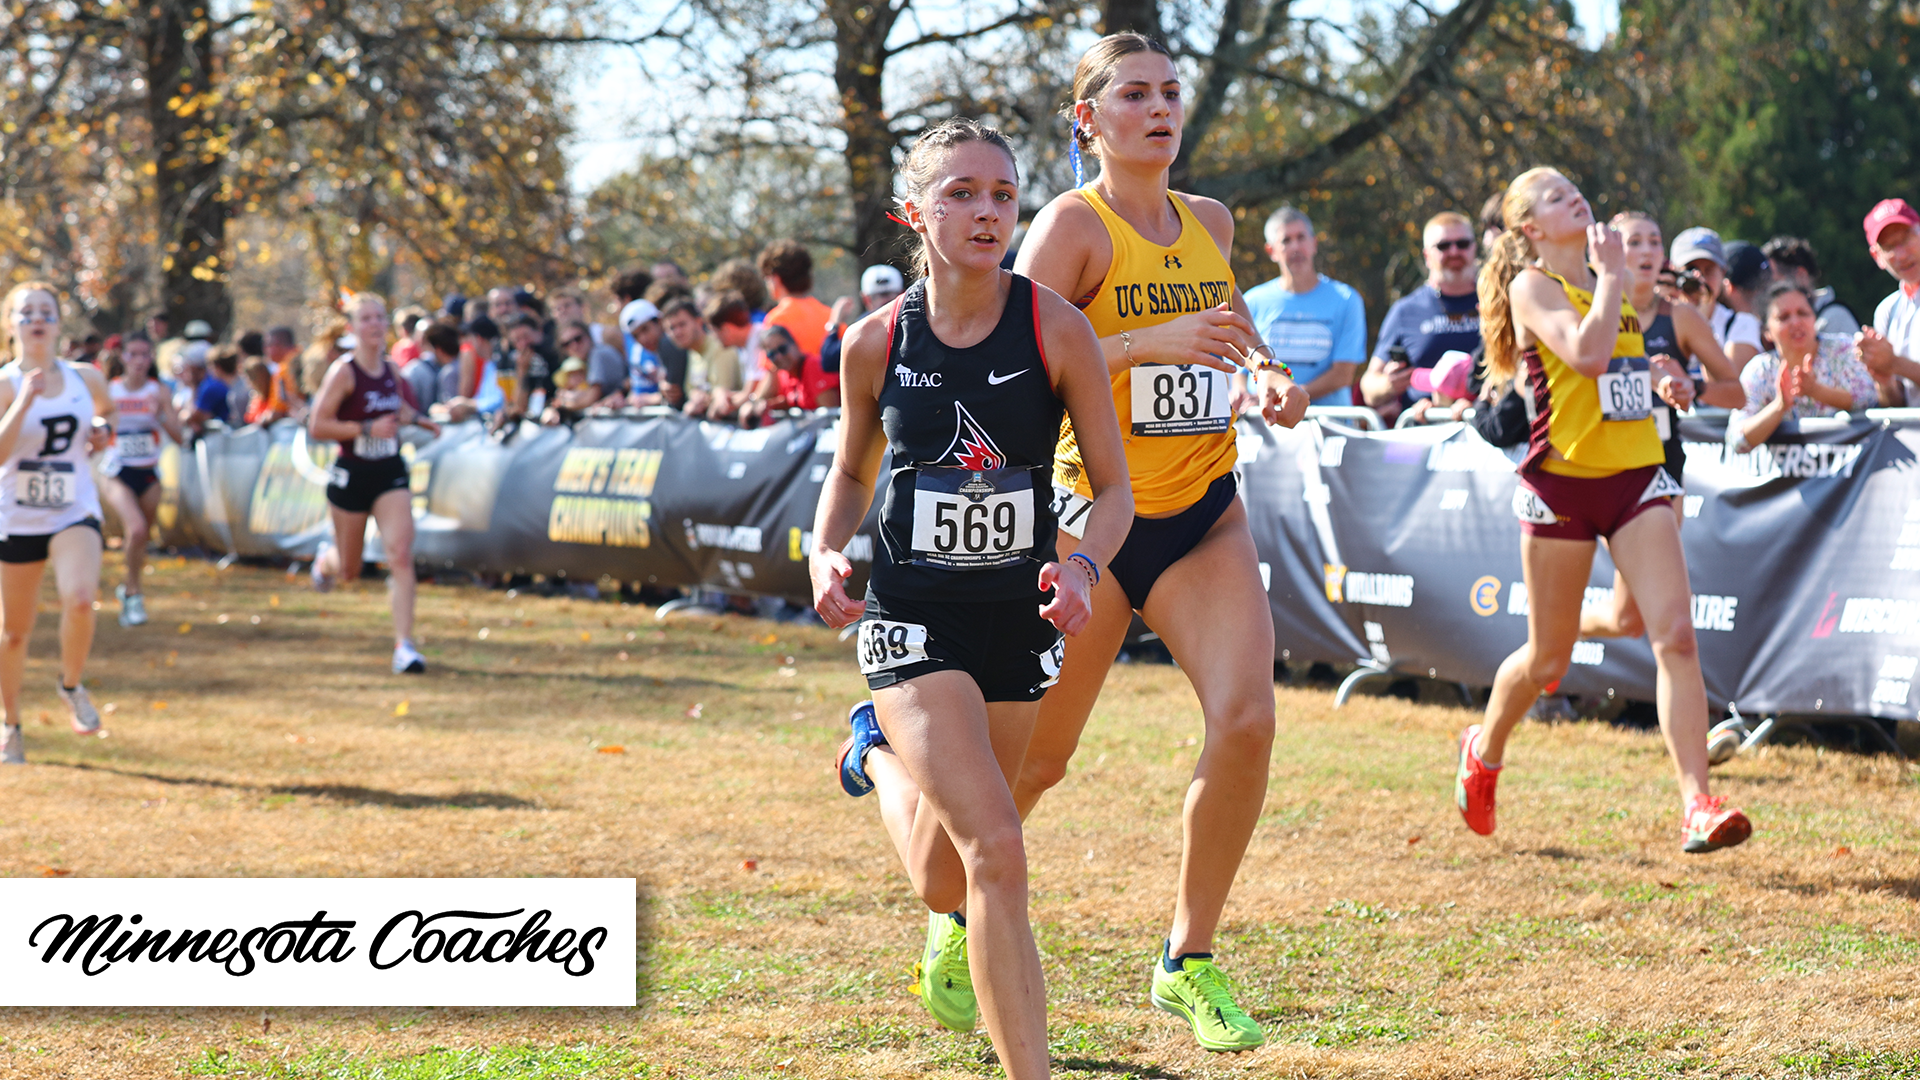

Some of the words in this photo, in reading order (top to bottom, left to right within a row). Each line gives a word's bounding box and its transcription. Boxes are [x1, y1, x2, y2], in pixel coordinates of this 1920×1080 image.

[1114, 283, 1144, 319] UC
[1147, 282, 1201, 316] SANTA
[900, 372, 943, 388] WIAC
[1153, 371, 1213, 420] 837
[1610, 377, 1644, 411] 639
[37, 414, 79, 457] B
[27, 475, 65, 503] 613
[553, 446, 615, 494] MEN'S
[606, 447, 664, 498] TEAM
[547, 494, 652, 549] CHAMPIONS
[934, 501, 1016, 553] 569
[1346, 571, 1414, 607] WILLIAMS
